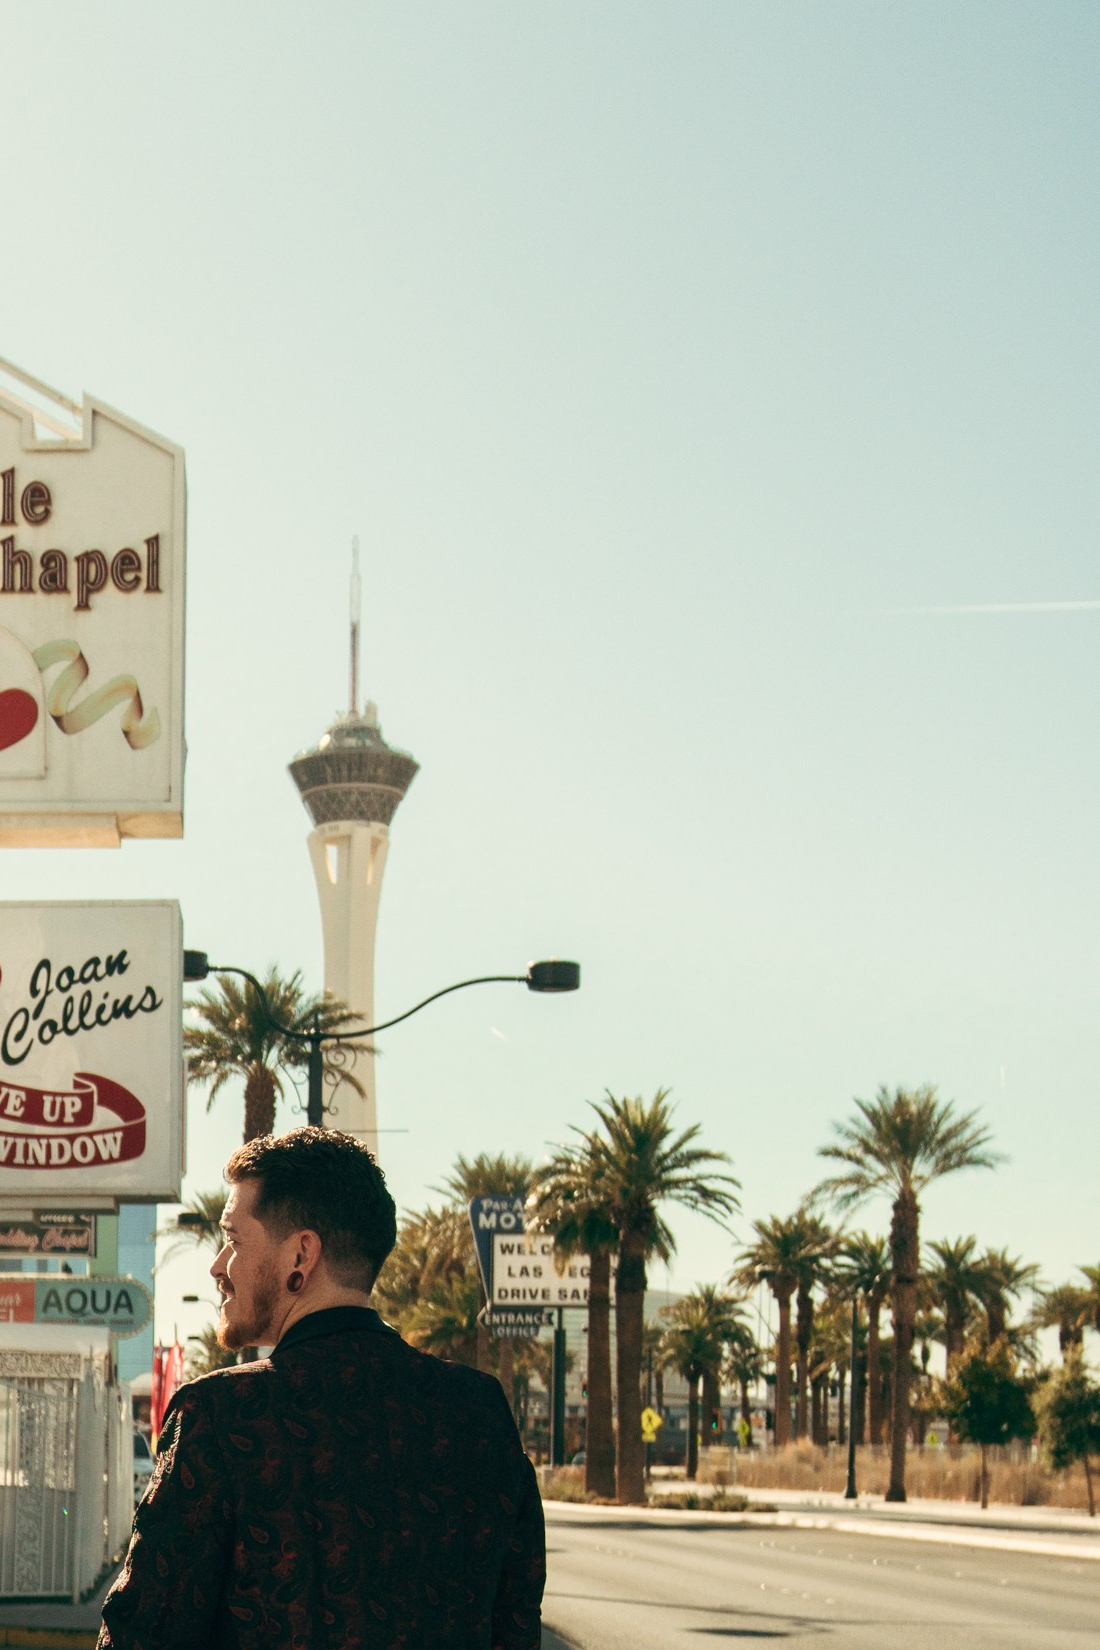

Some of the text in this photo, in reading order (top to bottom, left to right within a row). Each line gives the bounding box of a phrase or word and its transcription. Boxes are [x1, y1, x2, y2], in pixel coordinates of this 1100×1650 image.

[29, 949, 131, 1021] Joan
[0, 985, 164, 1066] Collins
[42, 1095, 82, 1123] UP
[507, 1265, 543, 1279] LAS
[42, 1288, 134, 1317] AQUA
[497, 1287, 551, 1301] DRIVE
[484, 1312, 549, 1326] ENTRANCE
[497, 1326, 538, 1338] OFFICE
